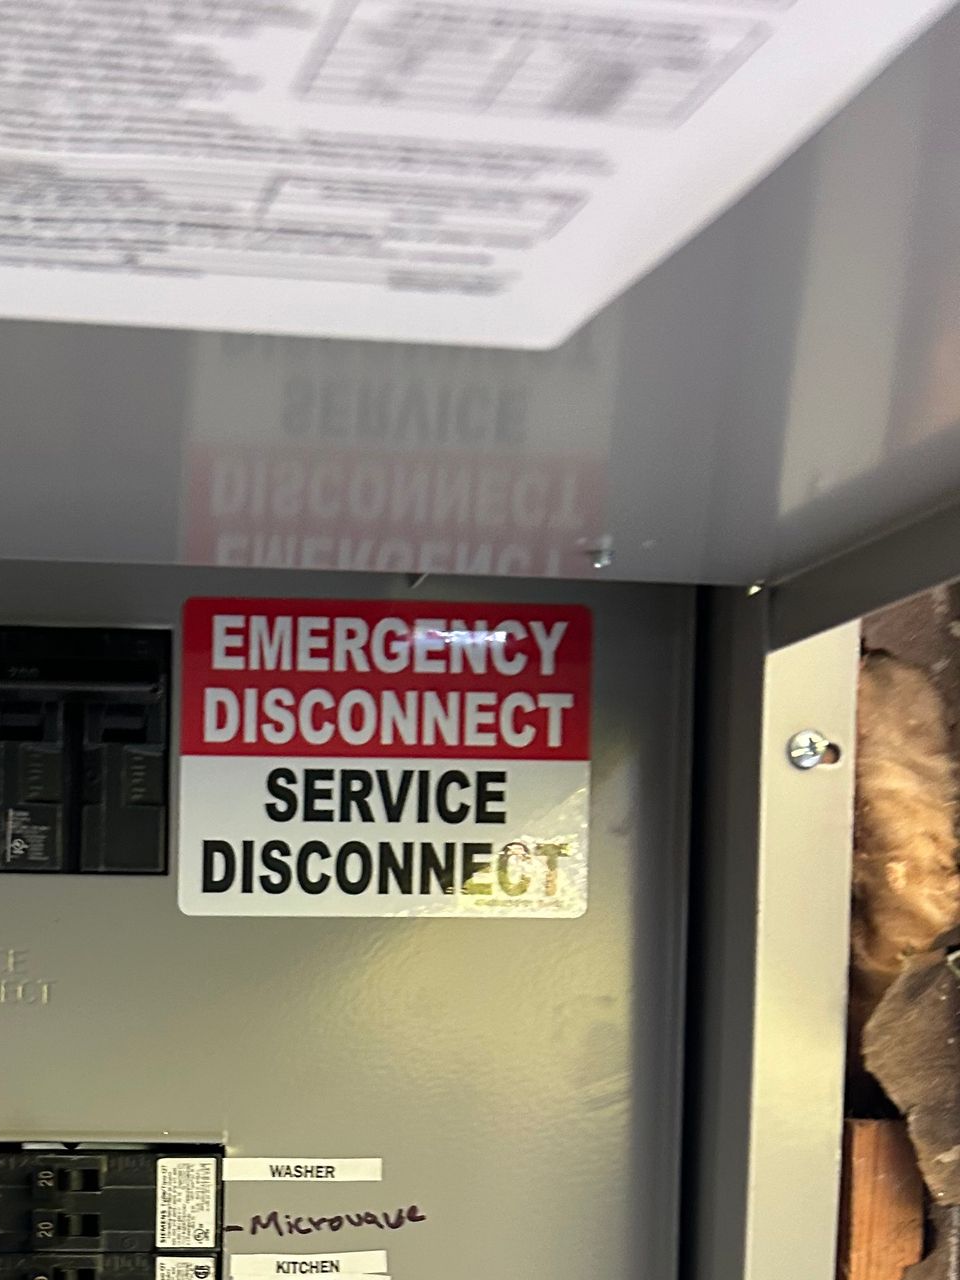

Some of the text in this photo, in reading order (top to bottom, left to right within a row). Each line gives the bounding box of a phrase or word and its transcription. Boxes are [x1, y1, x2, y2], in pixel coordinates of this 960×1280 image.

[212, 614, 569, 676] EMERGENCY
[203, 688, 574, 747] DISCONNECT
[265, 768, 507, 824] SERVICE
[202, 840, 571, 896] DISCONNECT
[39, 1170, 54, 1187] 20
[270, 1165, 335, 1179] WASHER
[39, 1221, 54, 1239] 20
[276, 1260, 340, 1274] KITCHEN
